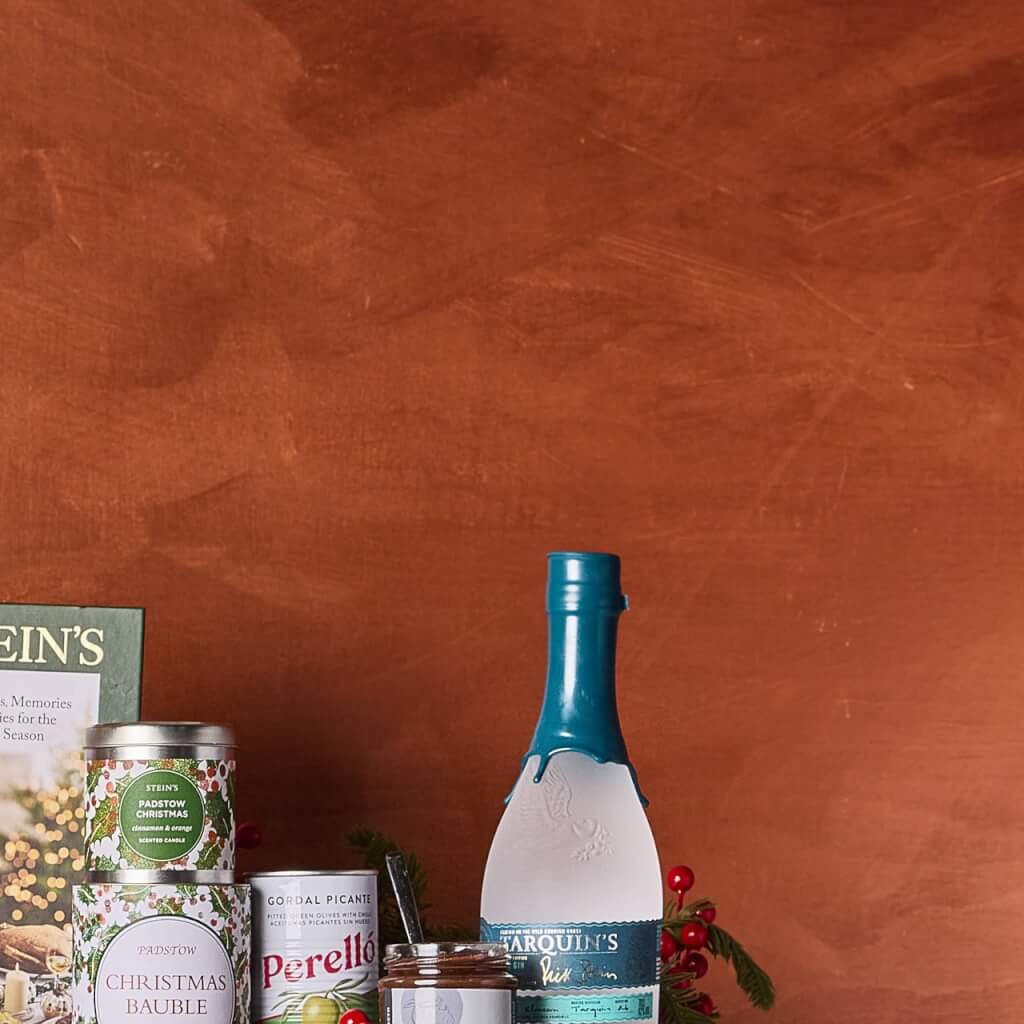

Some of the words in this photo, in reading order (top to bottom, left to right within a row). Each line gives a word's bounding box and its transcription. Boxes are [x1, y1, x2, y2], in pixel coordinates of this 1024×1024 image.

[11, 695, 72, 709] Memories
[17, 712, 36, 724] for
[38, 712, 57, 725] the
[3, 728, 44, 741] Season
[145, 784, 179, 792] STEIN'S
[138, 799, 186, 808] PADSTOW
[136, 809, 189, 818] CHRISTMAS
[267, 895, 321, 906] GORDAL
[326, 894, 372, 905] PICANTE
[137, 944, 197, 956] PADSTOW
[106, 974, 227, 991] CHRISTMAS
[127, 998, 208, 1015] BAUBLE
